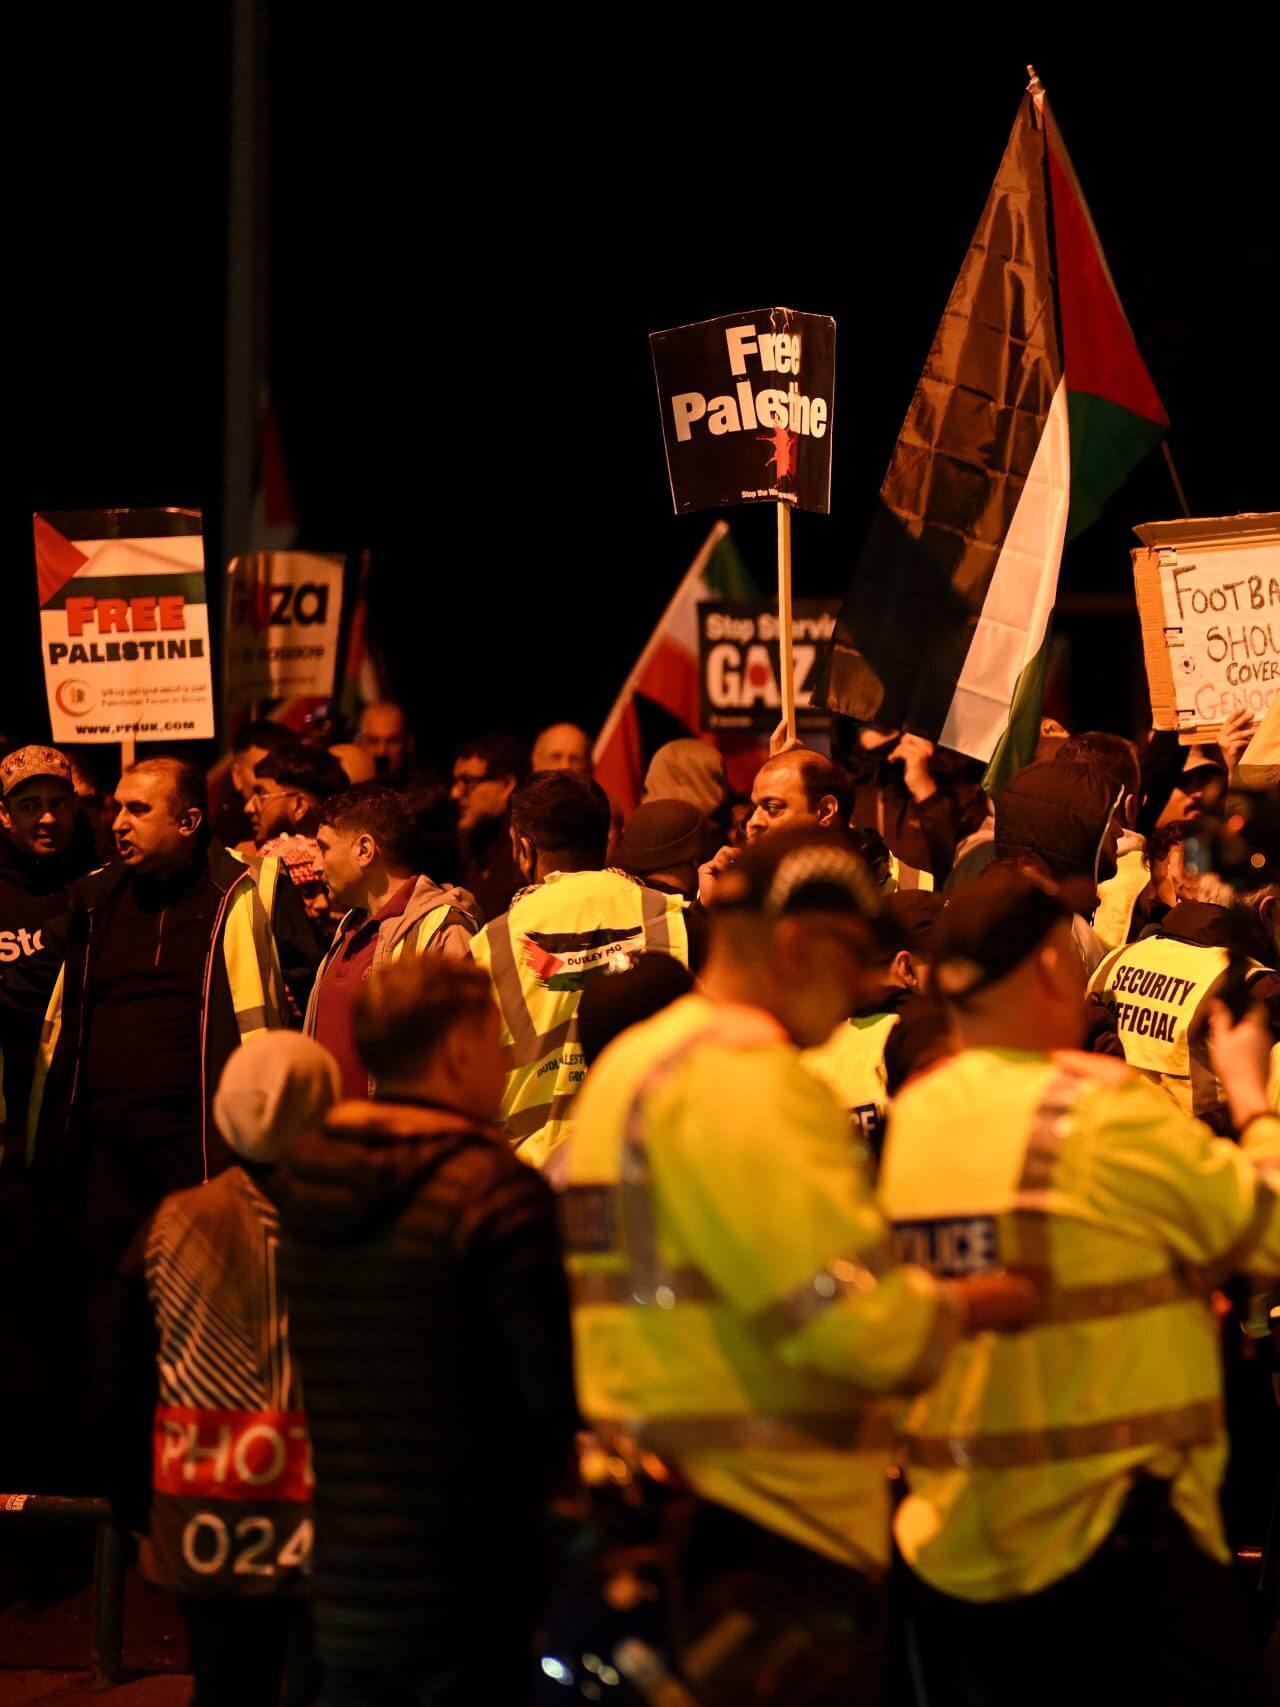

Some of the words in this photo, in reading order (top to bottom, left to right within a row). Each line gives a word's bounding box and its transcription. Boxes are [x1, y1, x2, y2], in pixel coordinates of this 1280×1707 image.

[725, 324, 801, 376] Free
[66, 596, 186, 637] FREE
[705, 612, 755, 645] Stop
[48, 638, 205, 665] PALESTINE
[1112, 965, 1197, 1007] SECURITY
[1115, 1002, 1179, 1043] FFICIAL
